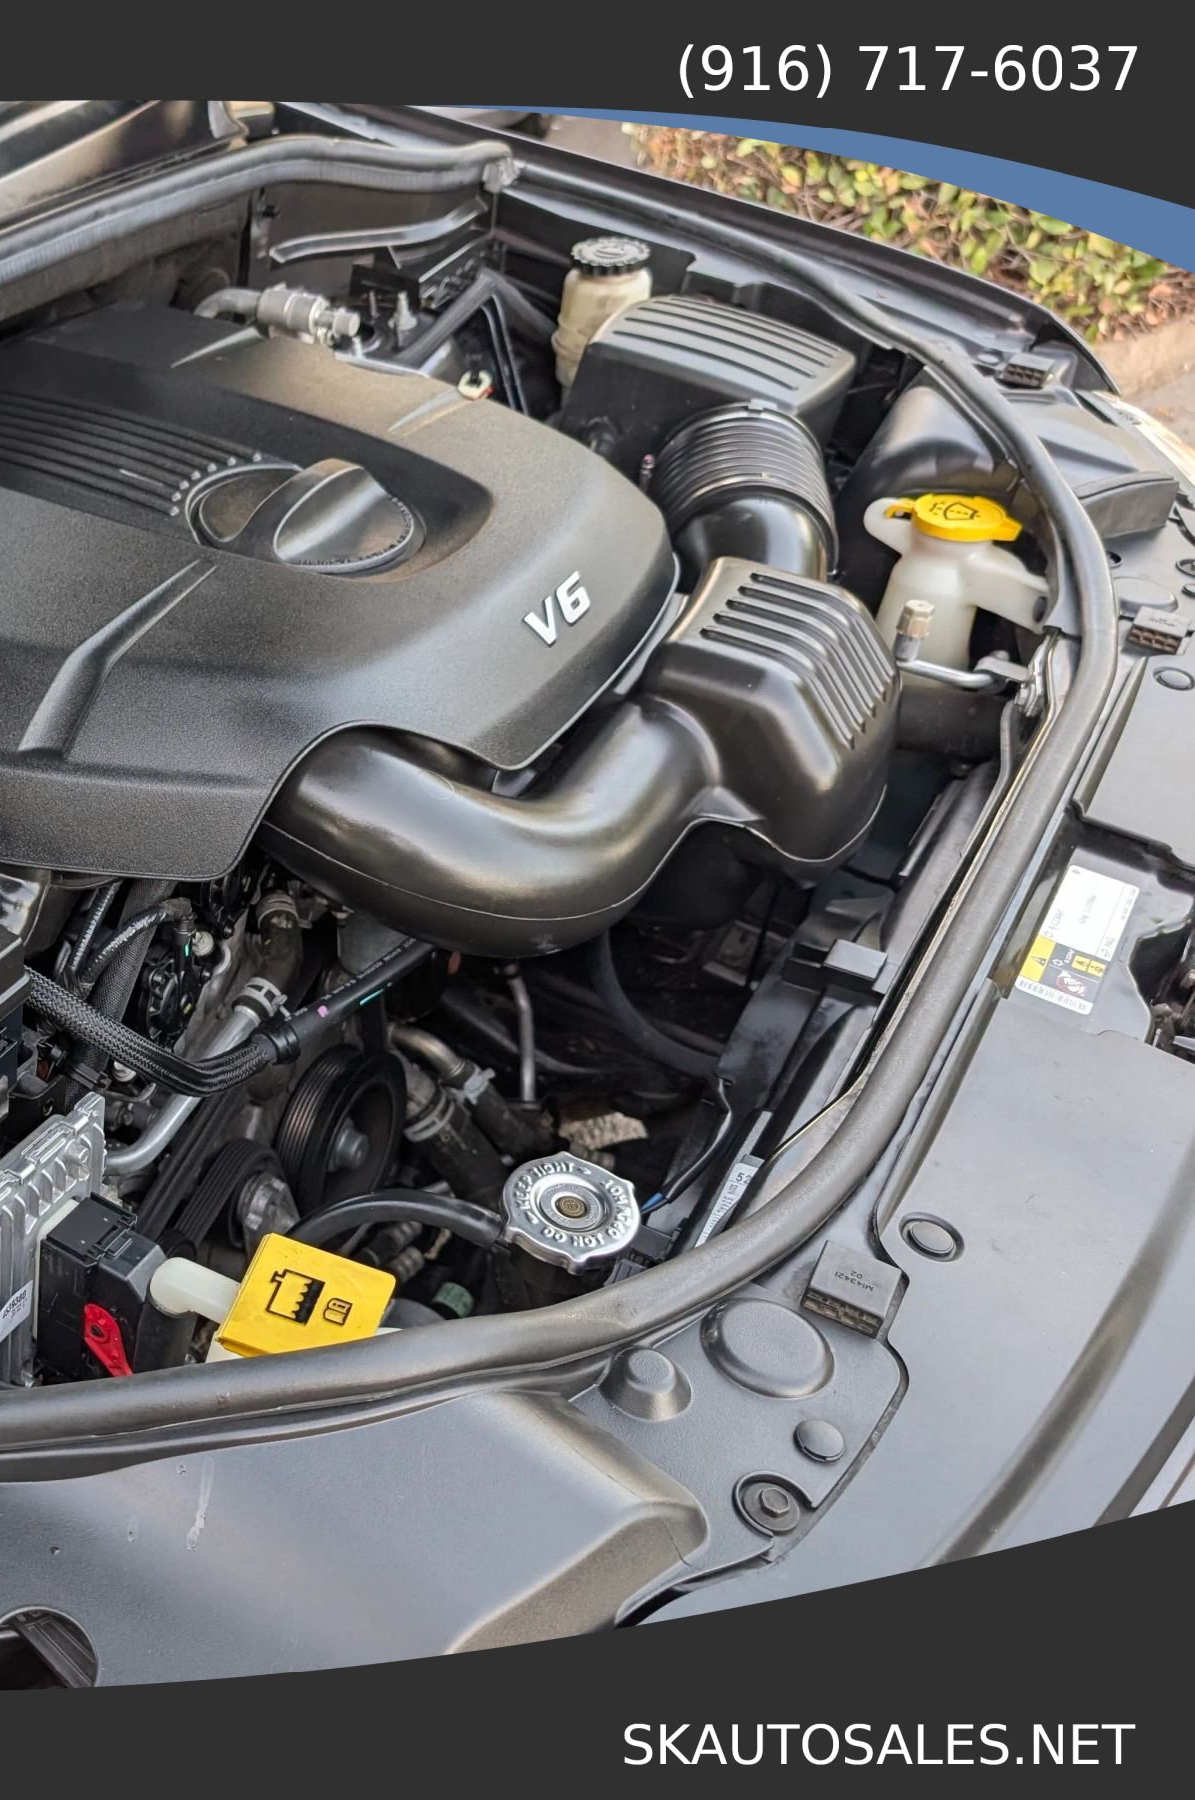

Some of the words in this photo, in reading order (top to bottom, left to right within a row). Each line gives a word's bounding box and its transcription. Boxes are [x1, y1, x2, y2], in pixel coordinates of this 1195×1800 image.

[522, 570, 590, 646] V6
[514, 1174, 532, 1209] KEEP
[572, 1232, 605, 1248] NOT
